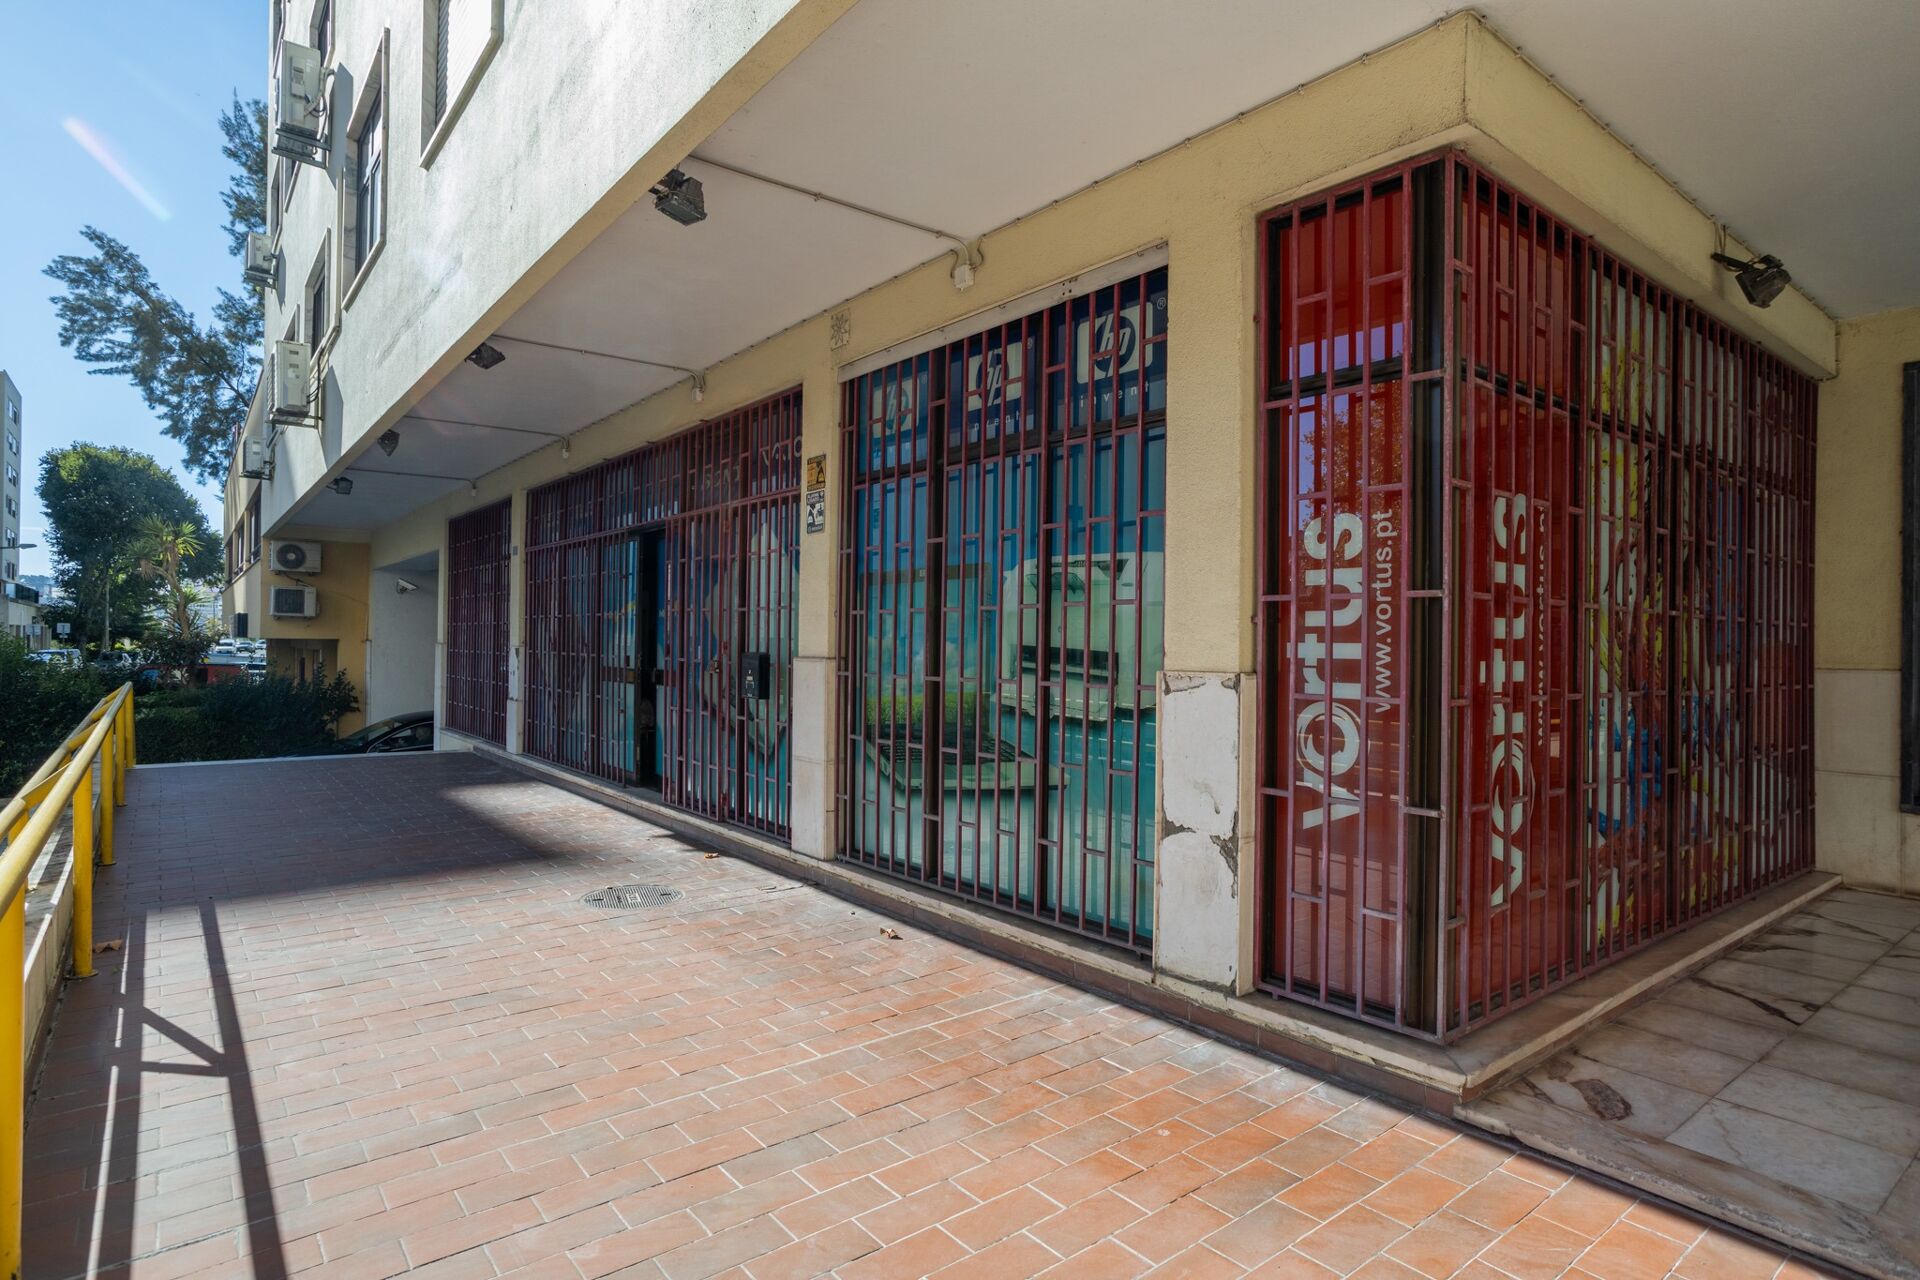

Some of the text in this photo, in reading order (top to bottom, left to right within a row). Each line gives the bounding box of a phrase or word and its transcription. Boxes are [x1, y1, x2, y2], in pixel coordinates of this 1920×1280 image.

[972, 409, 1020, 431] nent
[1287, 512, 1365, 829] vortus
[1371, 508, 1398, 713] www.vortus.pt
[1480, 493, 1528, 907] vortus
